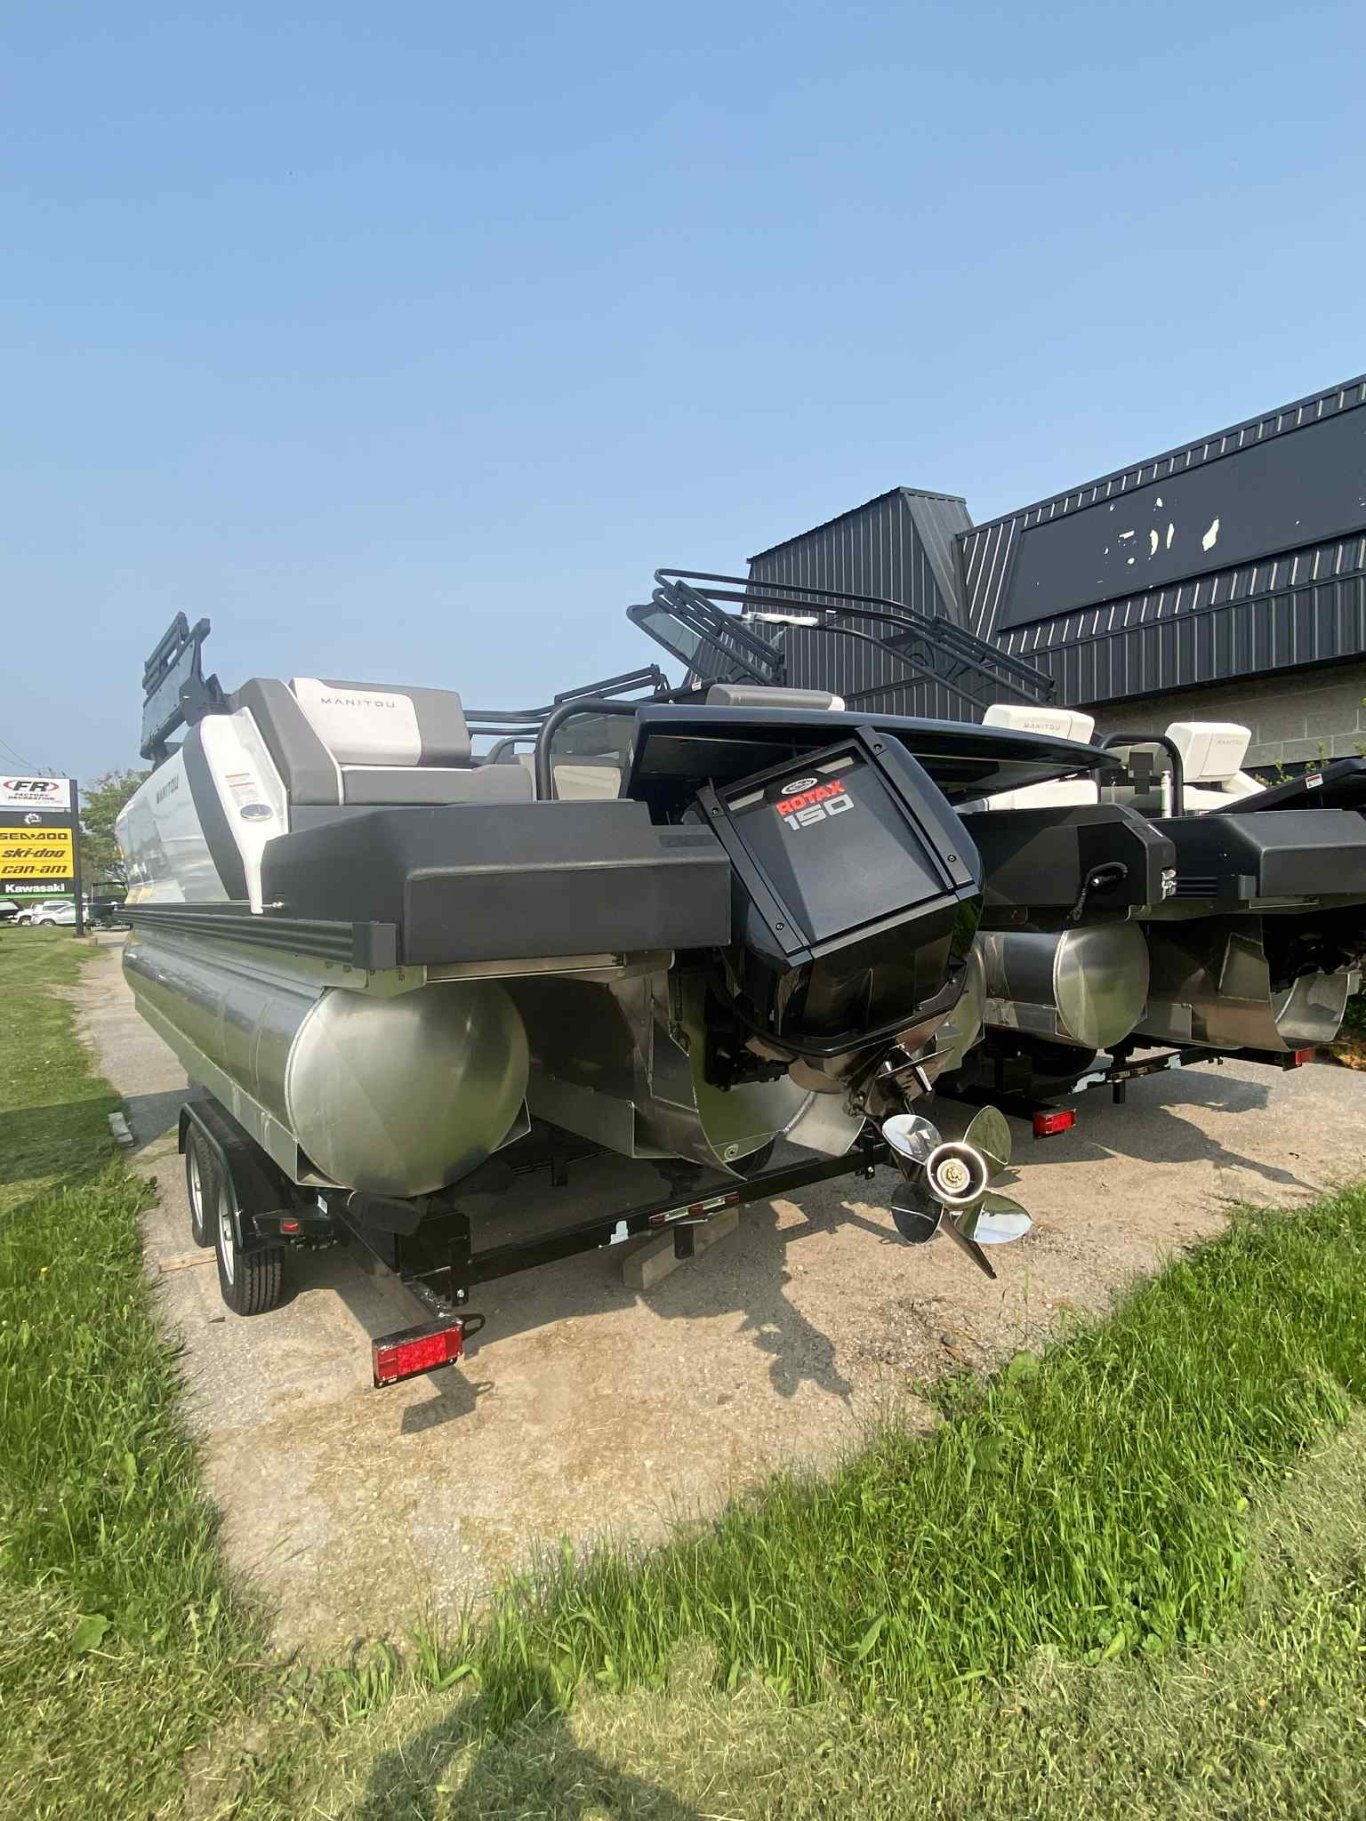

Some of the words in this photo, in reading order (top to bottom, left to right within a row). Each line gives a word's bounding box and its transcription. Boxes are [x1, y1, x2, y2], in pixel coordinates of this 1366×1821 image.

[321, 698, 396, 708] MANITOU
[13, 781, 49, 792] FR
[776, 779, 845, 816] ROTAX
[784, 794, 855, 830] 150
[1, 848, 66, 858] ski-doo
[1, 865, 67, 874] can-am
[5, 883, 65, 893] Kawasaki
